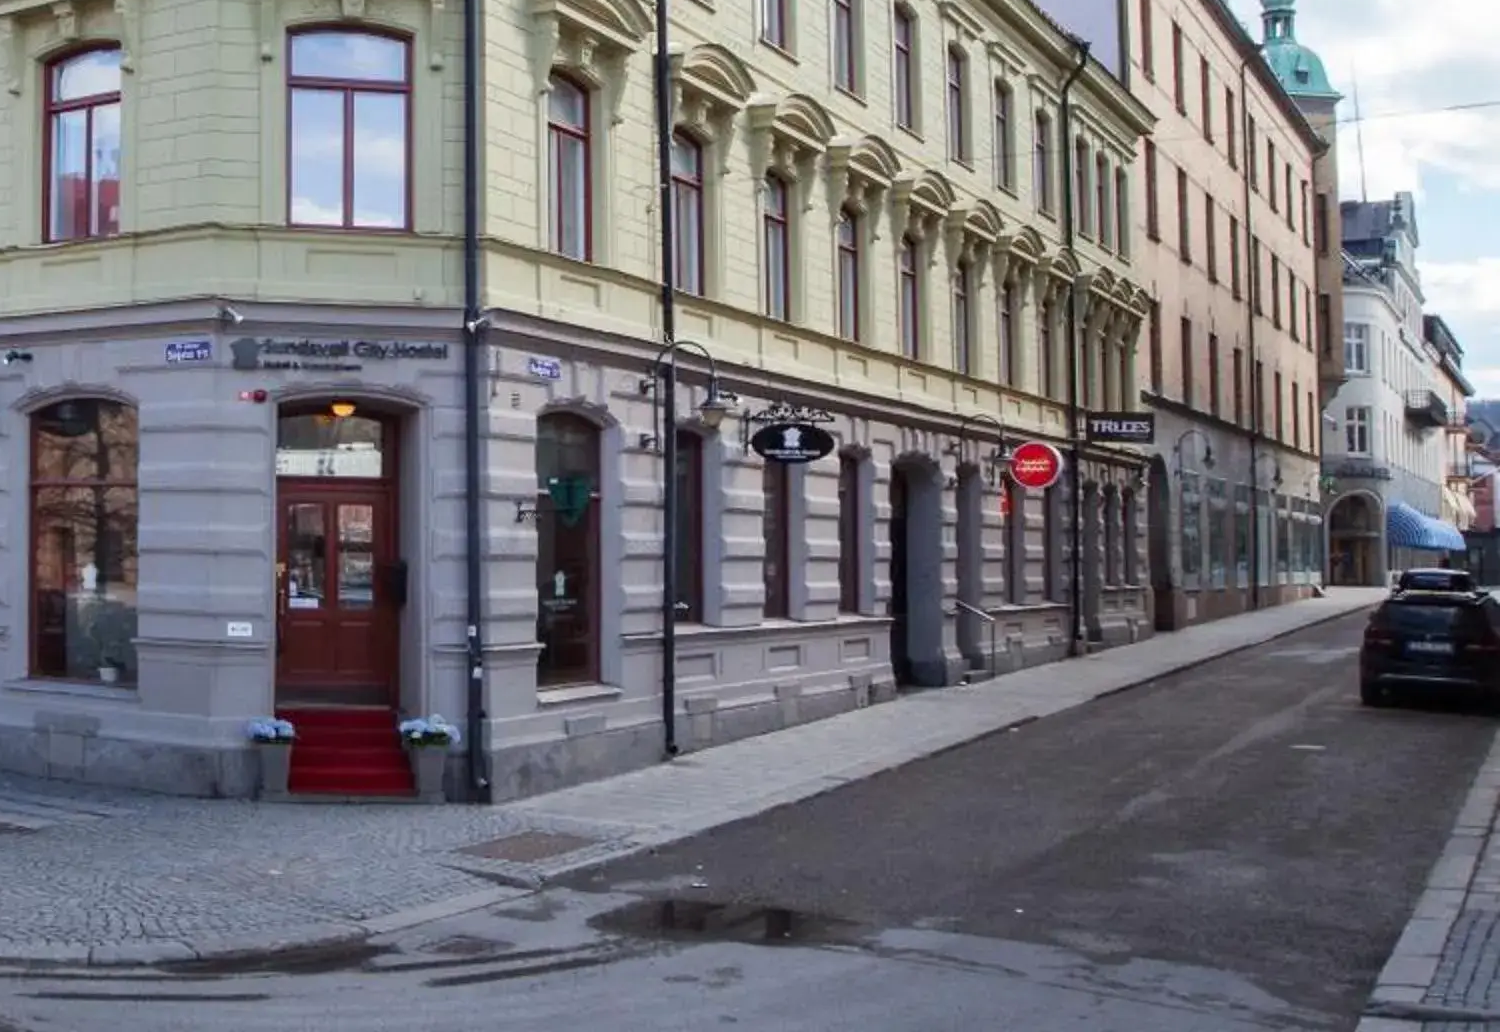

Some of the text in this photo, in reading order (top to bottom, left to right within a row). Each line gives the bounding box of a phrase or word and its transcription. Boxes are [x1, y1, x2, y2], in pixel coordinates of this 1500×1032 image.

[261, 339, 449, 359] Sundsvall City Hostel
